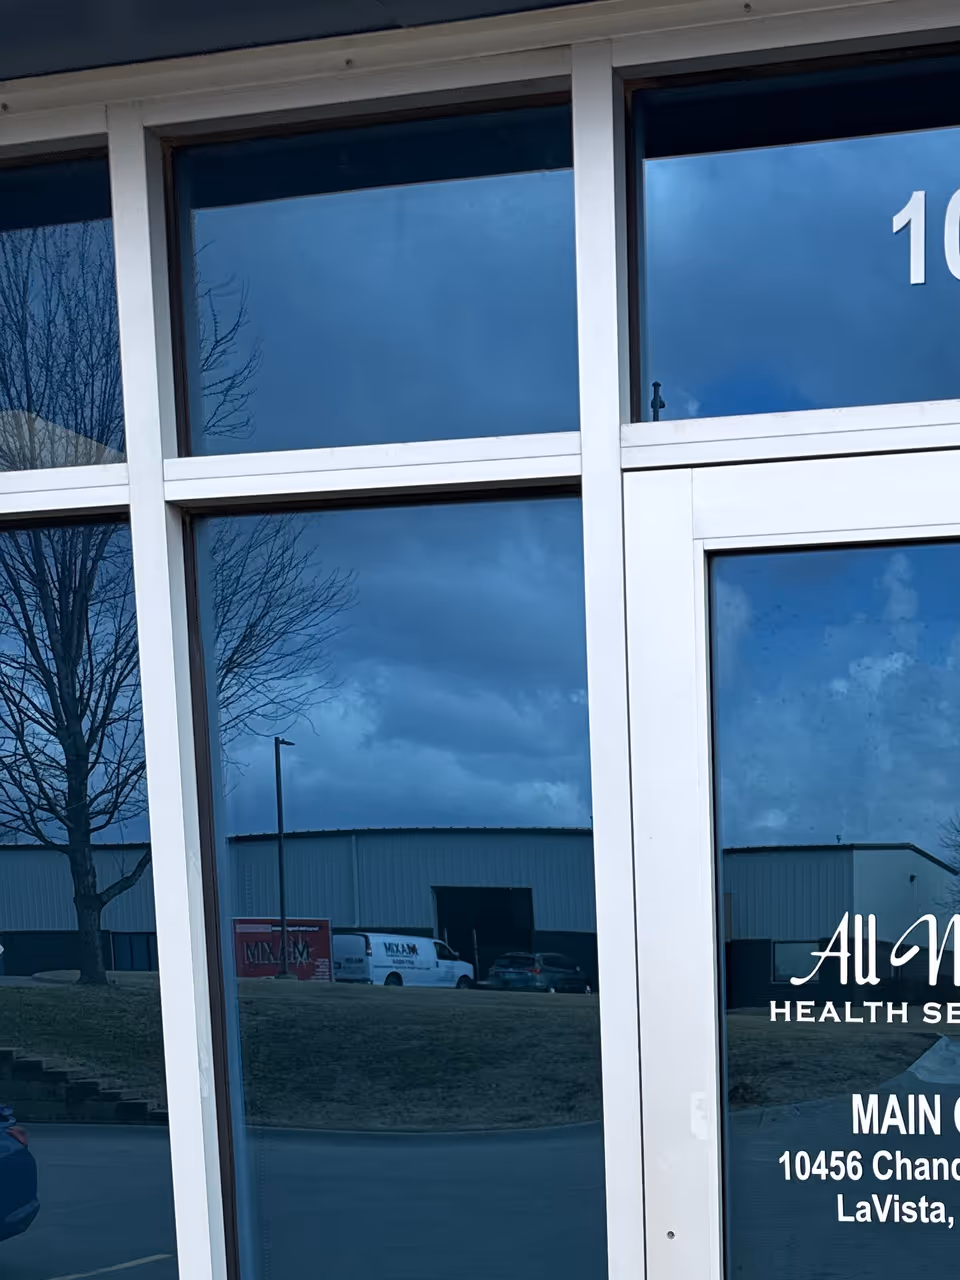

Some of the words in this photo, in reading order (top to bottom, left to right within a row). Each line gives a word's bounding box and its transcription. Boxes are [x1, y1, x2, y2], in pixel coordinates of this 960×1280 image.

[789, 911, 881, 986] All
[769, 1000, 909, 1024] HEALTH
[852, 1093, 941, 1135] MAIN
[778, 1150, 863, 1181] 10456
[837, 1193, 954, 1229] LaVista,
